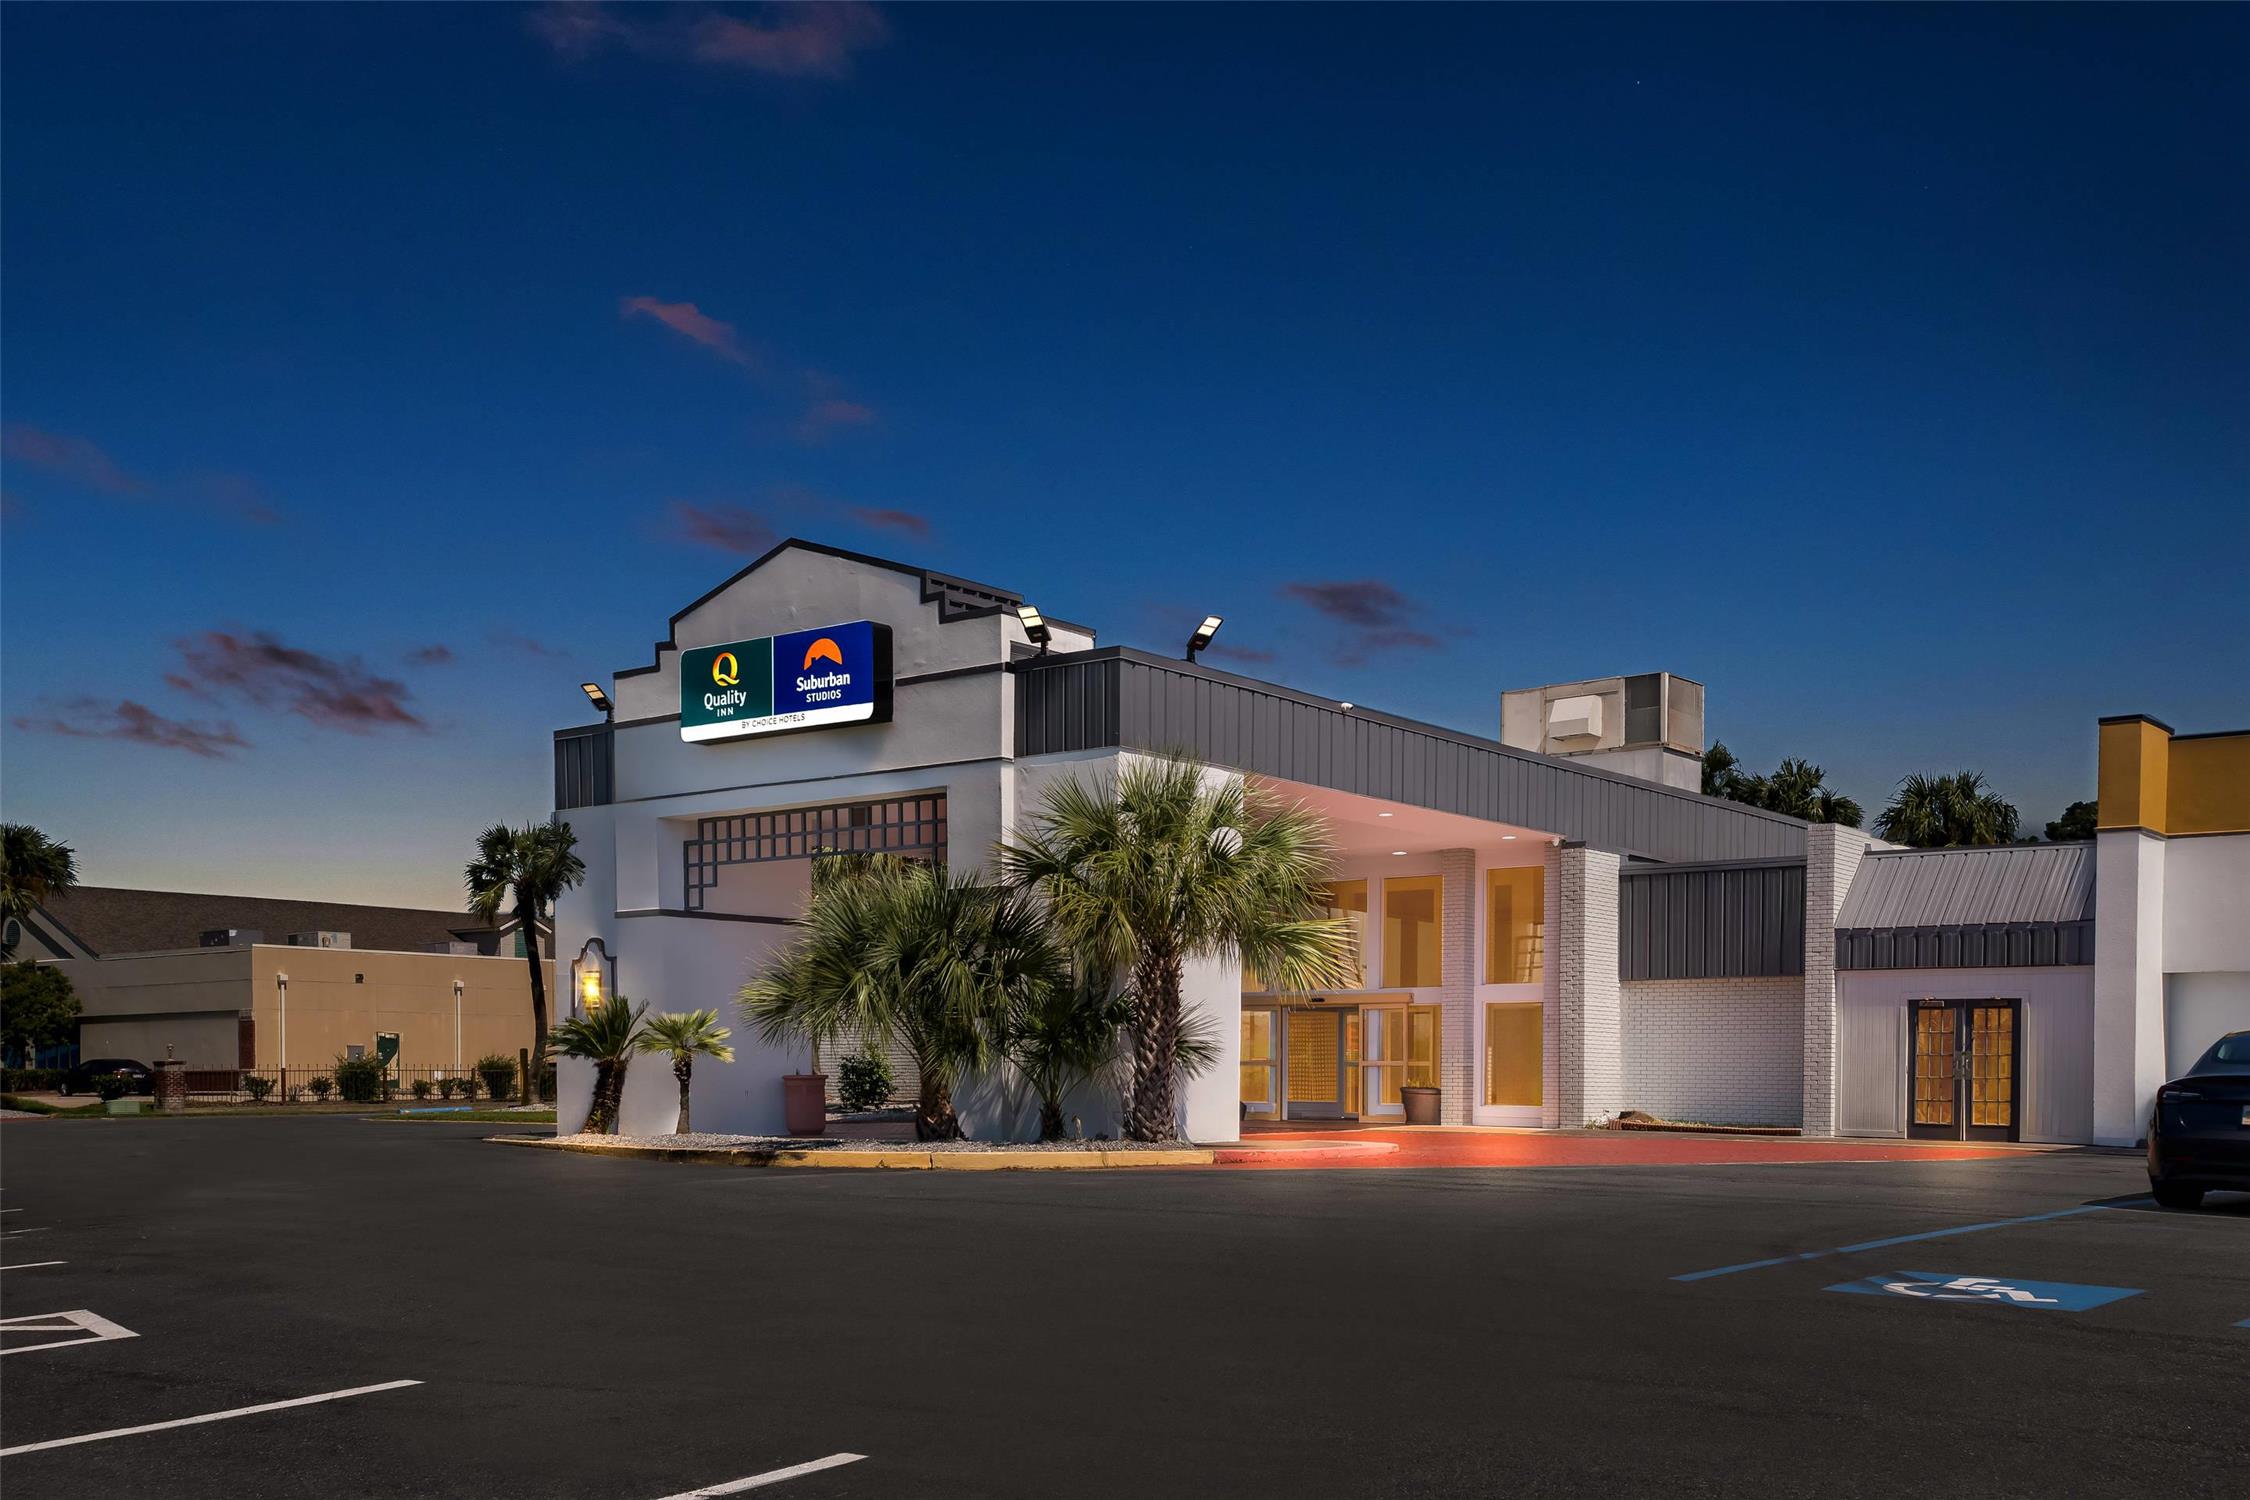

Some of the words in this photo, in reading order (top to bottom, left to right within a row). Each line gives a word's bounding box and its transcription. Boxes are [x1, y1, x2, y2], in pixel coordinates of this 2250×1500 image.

[712, 652, 740, 687] Q
[796, 672, 851, 692] Suburban
[704, 689, 747, 710] Quality
[806, 689, 842, 703] STUDIOS
[716, 706, 734, 717] INN
[741, 721, 750, 729] BY
[751, 717, 777, 728] CHOICE
[778, 713, 806, 723] HOTELS
